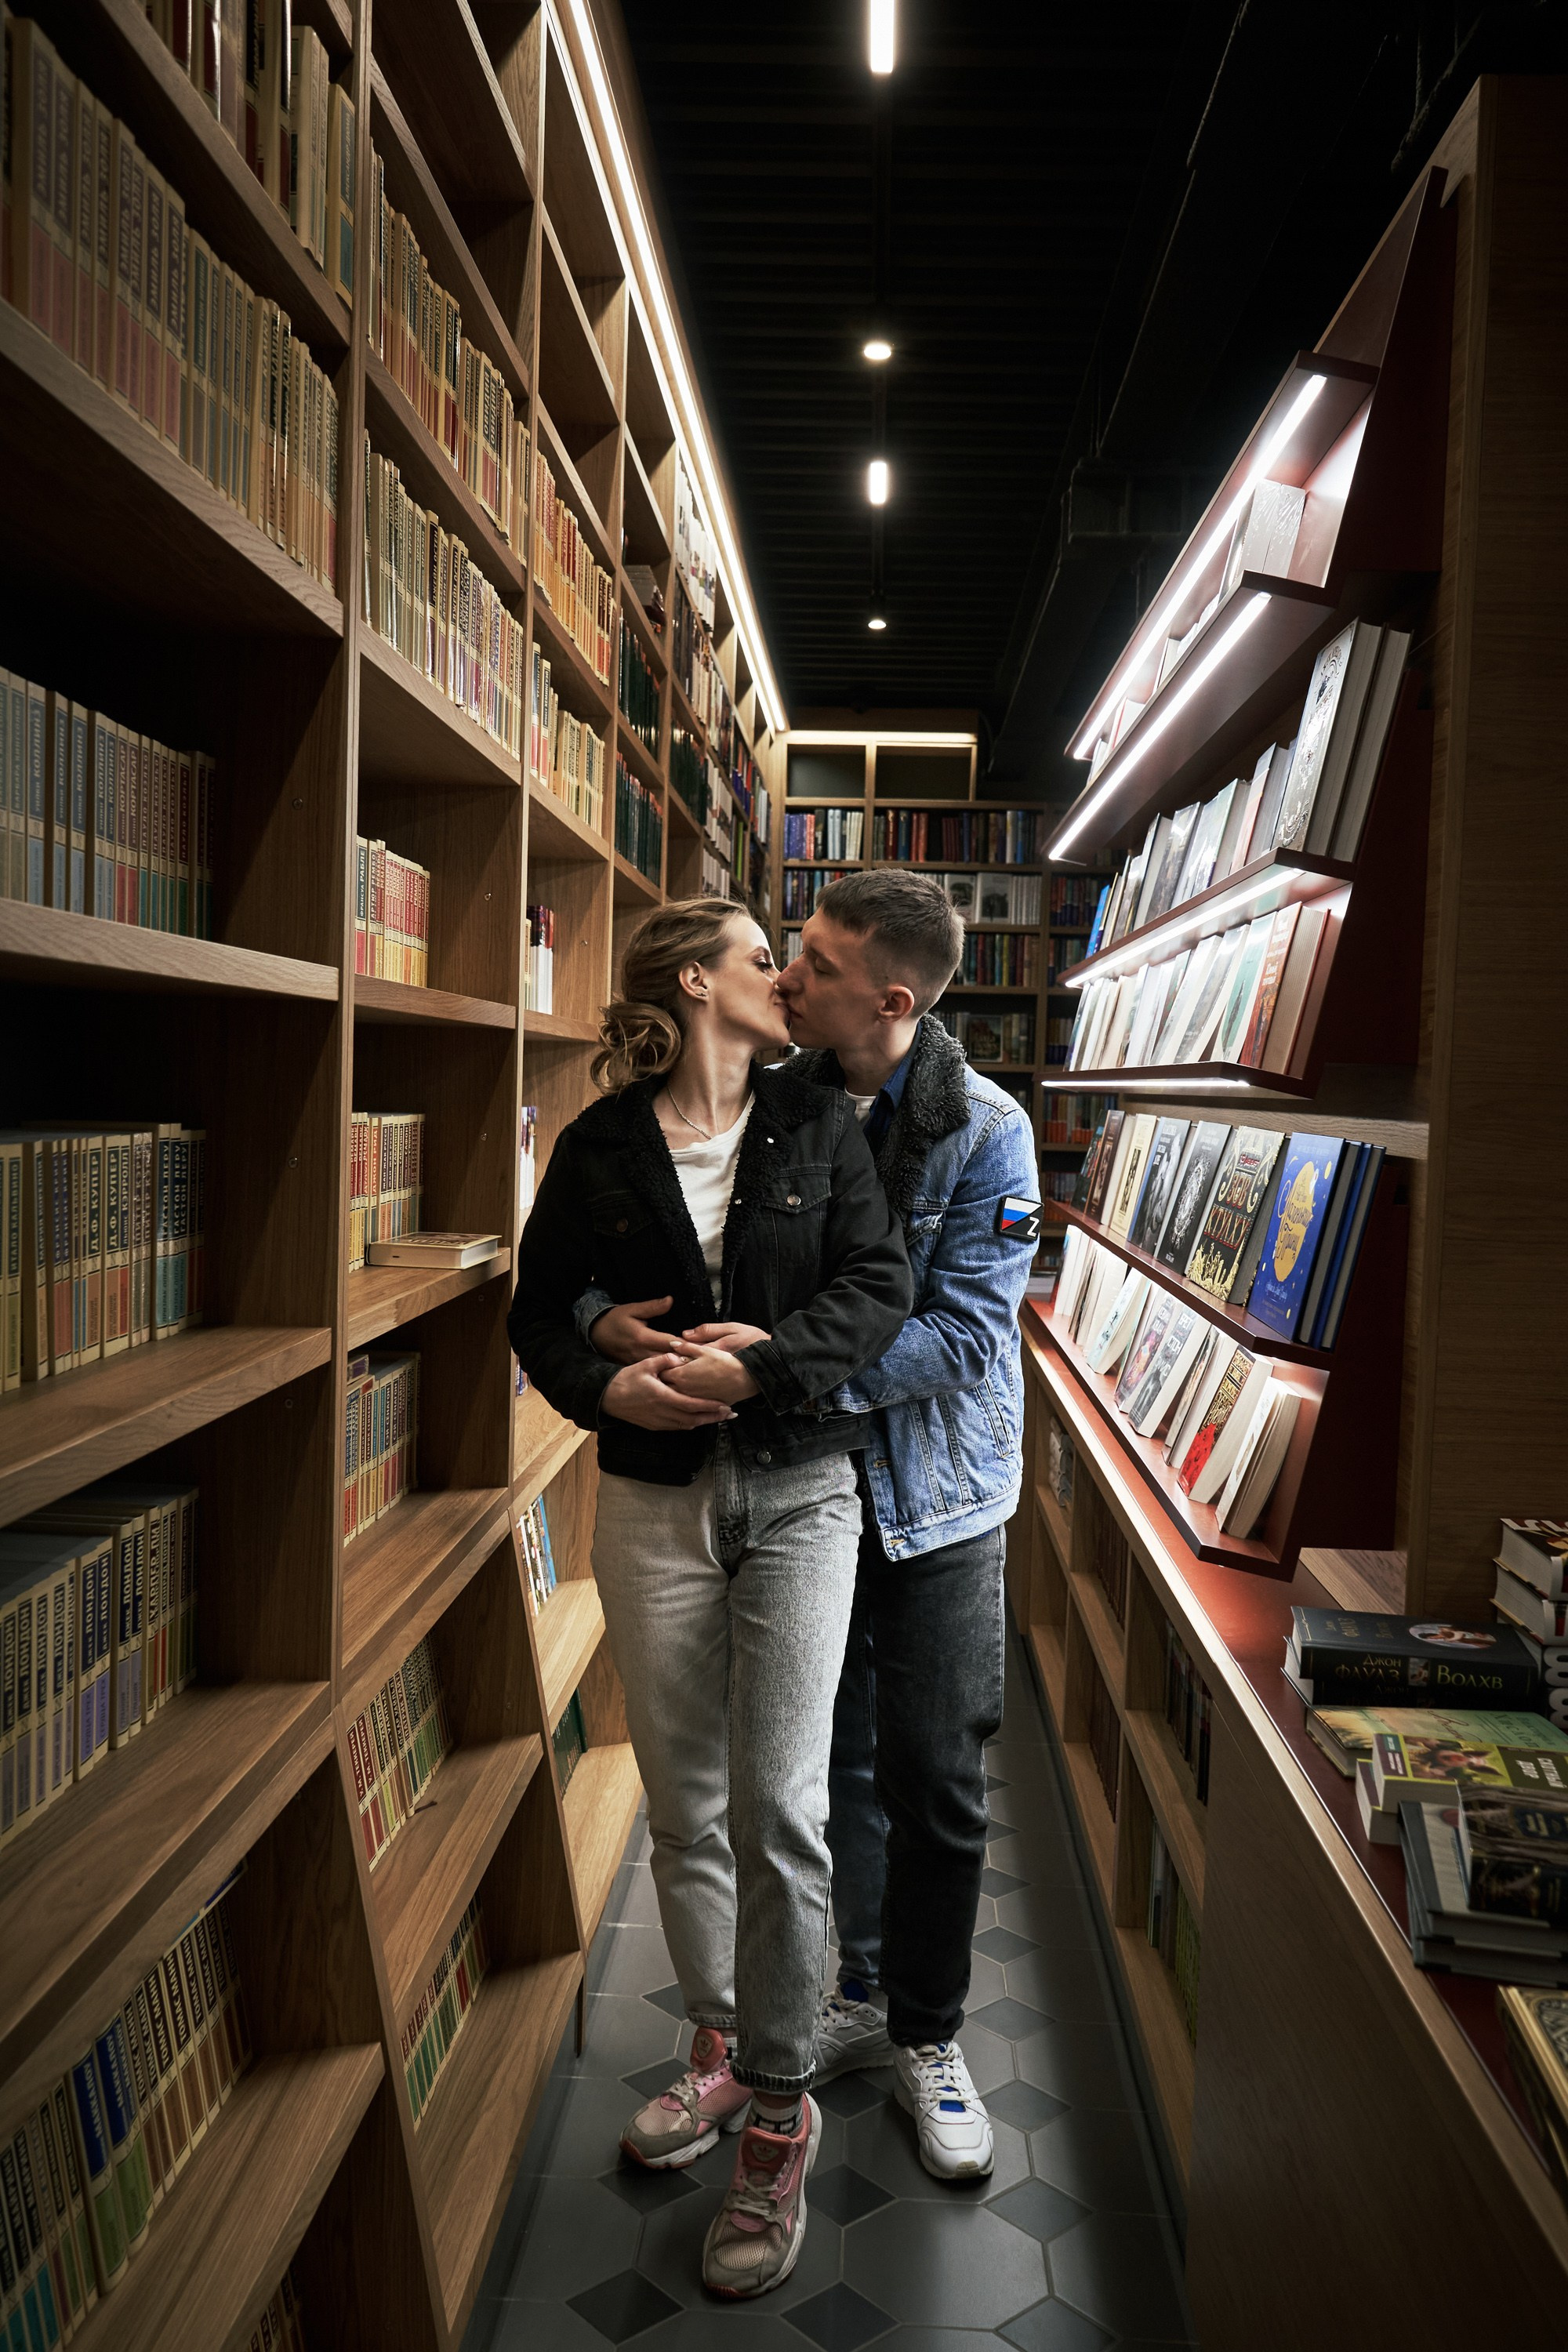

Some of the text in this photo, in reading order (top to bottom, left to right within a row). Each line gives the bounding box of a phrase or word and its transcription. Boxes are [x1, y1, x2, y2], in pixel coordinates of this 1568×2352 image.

[1227, 1173, 1252, 1209] ЗОВ
[109, 1210, 118, 1247] Д.Ф.
[1027, 1216, 1040, 1237] Z
[1203, 1203, 1250, 1250] КТУЛХУ
[100, 1555, 109, 1621] ЛОНДОН
[122, 1542, 132, 1604] ЛОНДОН
[136, 1534, 144, 1595] ЛОНДОН
[55, 1589, 64, 1656] ЛОНДОН
[85, 1568, 95, 1633] ЛОНДОН
[4, 1619, 14, 1691] ЛОНДОН
[20, 1606, 31, 1676] ЛОНДОН
[38, 1600, 48, 1670] ЛОНДОН
[348, 1732, 361, 1773] ТЕККЕРЕЙ
[358, 1719, 370, 1761] ТЕККЕРЕЙ
[366, 1762, 372, 1773] М.
[358, 1775, 363, 1788] М.
[182, 1936, 202, 2024] ТОМАС МАНН
[196, 1921, 216, 2003] ТОМАС МАНН
[148, 1975, 170, 2069] ТОМАС МАНН
[166, 1955, 187, 2044] ТОМАС МАНН
[125, 2007, 147, 2097] ТОМАС МАНН
[136, 1994, 157, 2084] ТОМАС МАНН
